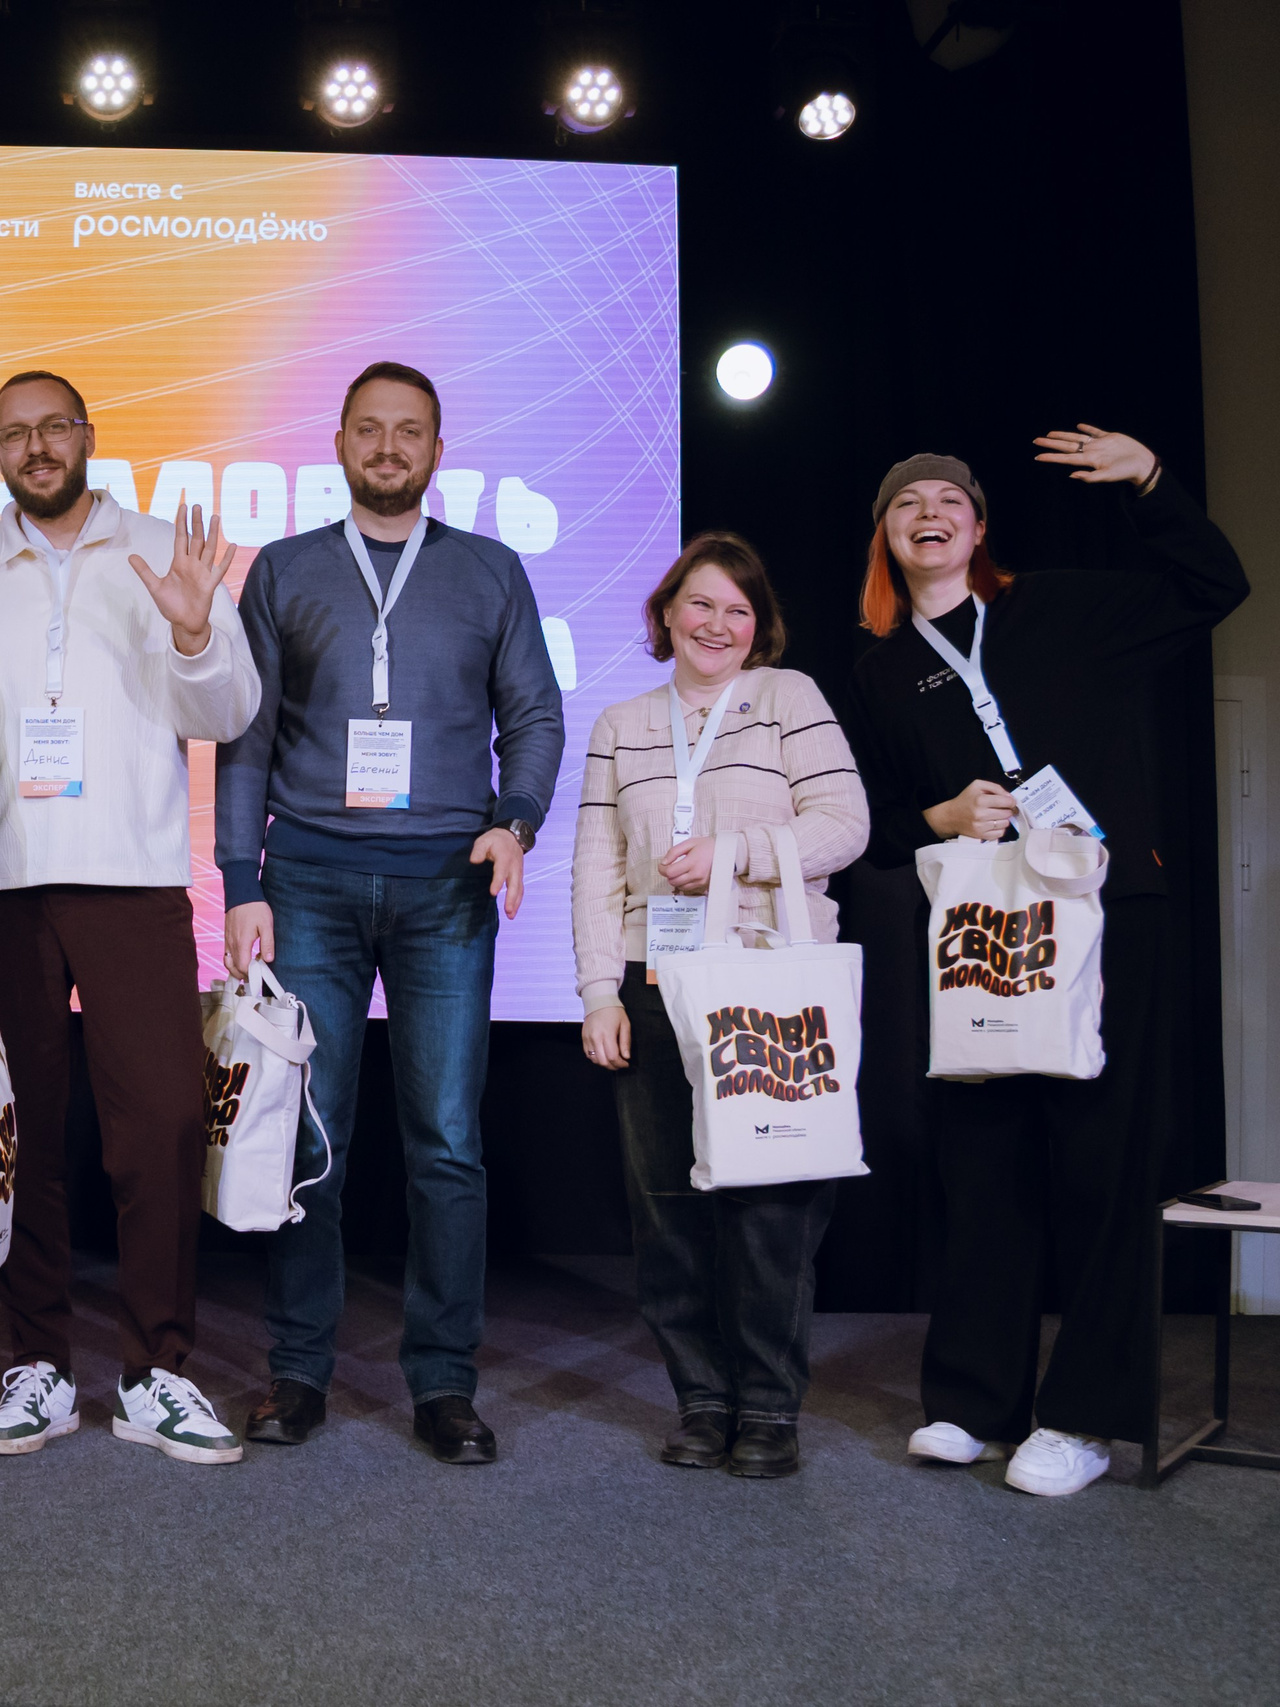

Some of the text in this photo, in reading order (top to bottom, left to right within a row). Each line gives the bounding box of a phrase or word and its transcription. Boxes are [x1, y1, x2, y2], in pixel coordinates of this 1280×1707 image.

[74, 182, 184, 200] вместе с
[73, 211, 329, 248] росмолодёжь
[350, 761, 401, 775] Евгений
[32, 784, 69, 792] ЭКСПЕРТ
[360, 795, 395, 803] ЭКСПЕРТ
[938, 900, 1055, 949] ЖИВИ
[649, 939, 695, 954] Екатерина
[936, 928, 1057, 979] СВОЮ
[938, 963, 1055, 998] МОЛОДОСТЬ
[706, 1005, 829, 1053] ЖИВИ
[710, 1032, 835, 1084] СВОЮ
[716, 1068, 841, 1102] МОЛОДОСТЬ
